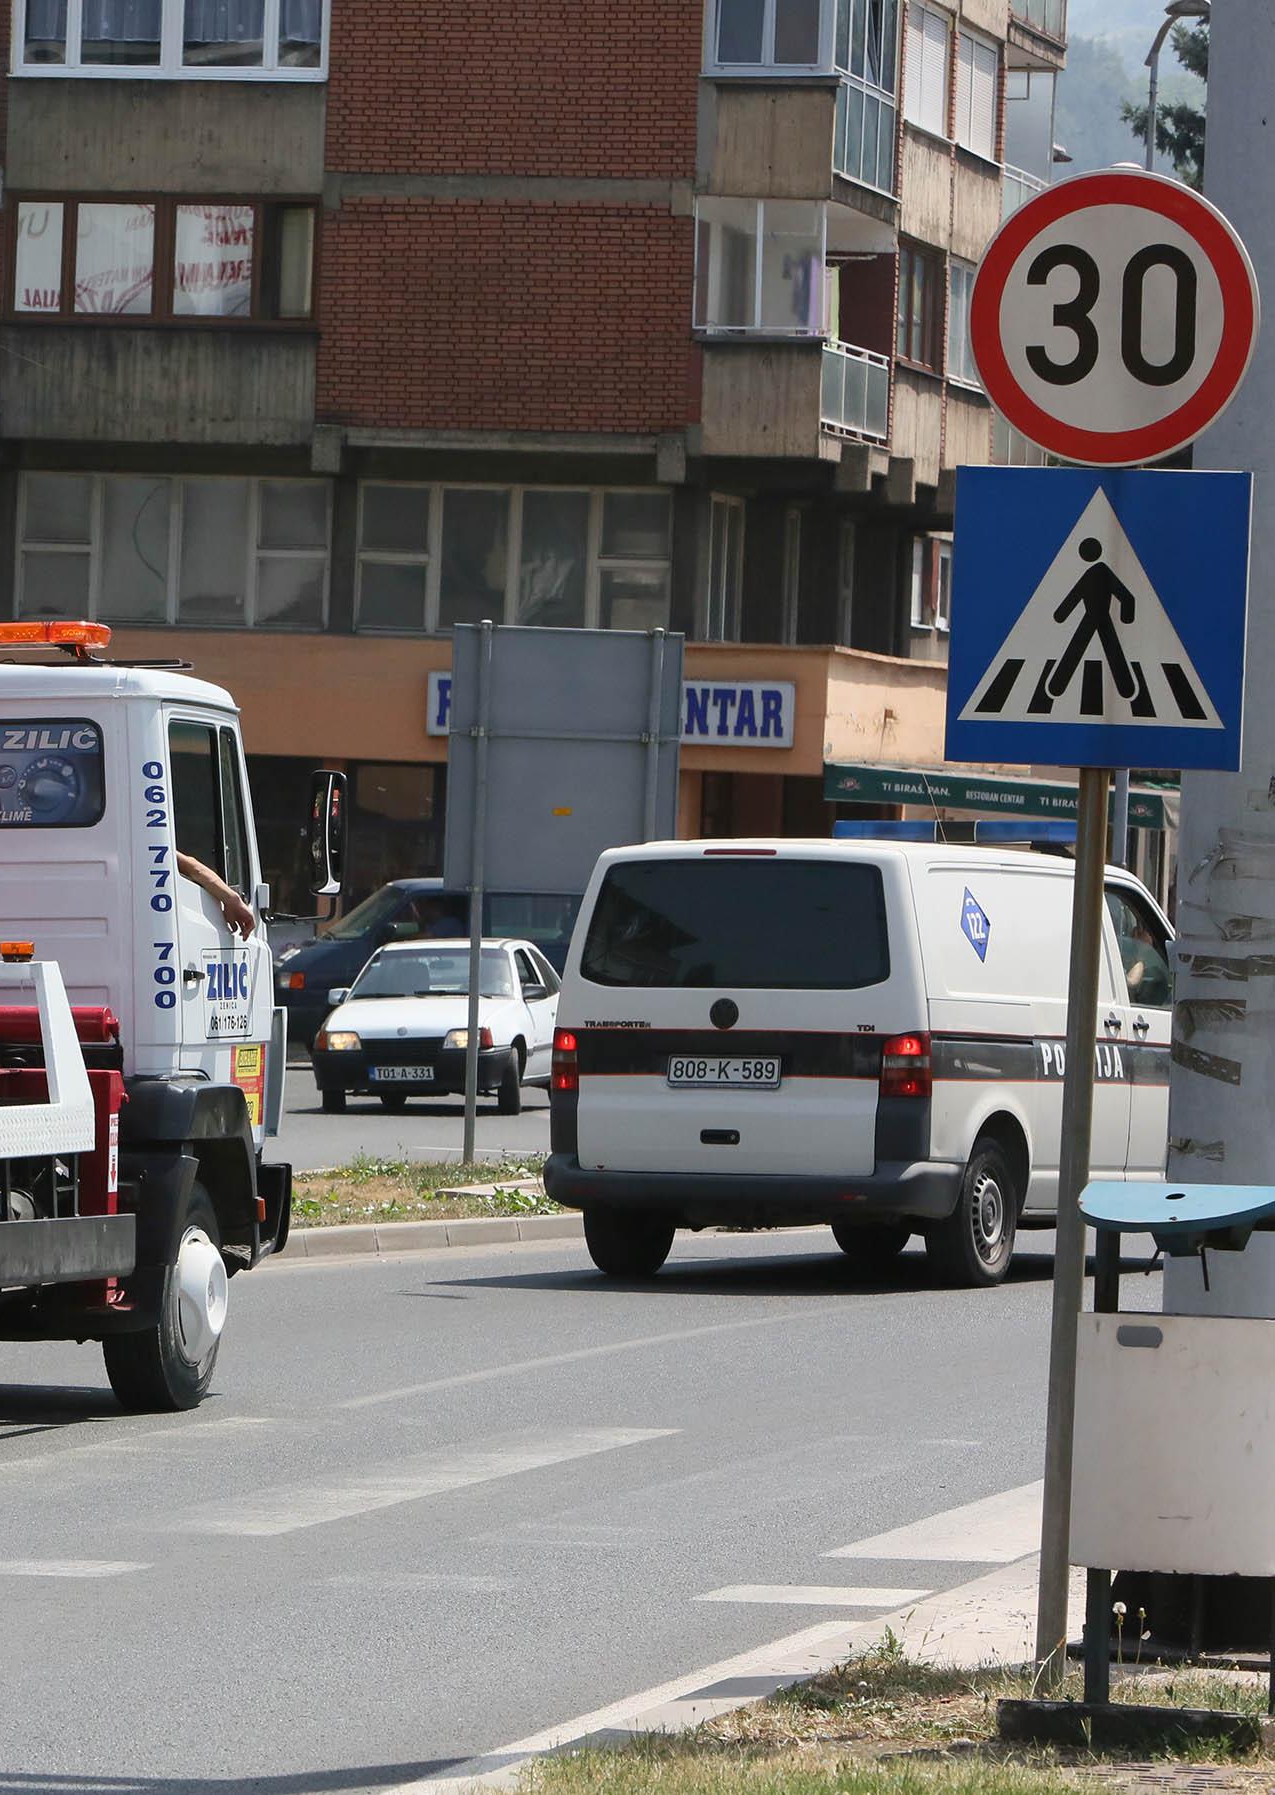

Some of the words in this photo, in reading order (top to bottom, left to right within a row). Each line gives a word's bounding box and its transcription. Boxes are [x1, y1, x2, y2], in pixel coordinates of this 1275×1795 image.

[1025, 243, 1198, 387] 30
[685, 686, 784, 738] NTAR
[2, 727, 98, 750] ZILIĆ
[882, 782, 892, 792] TI
[965, 790, 998, 803] RESTORAN
[999, 794, 1025, 806] CENTAR
[1040, 796, 1049, 807] TI
[966, 912, 986, 940] 122
[206, 951, 248, 1001] ZILIĆ
[857, 1024, 875, 1032] TDI
[673, 1060, 775, 1081] 808-K-589
[1040, 1042, 1124, 1079] POIJA
[377, 1067, 433, 1080] T01-A-331
